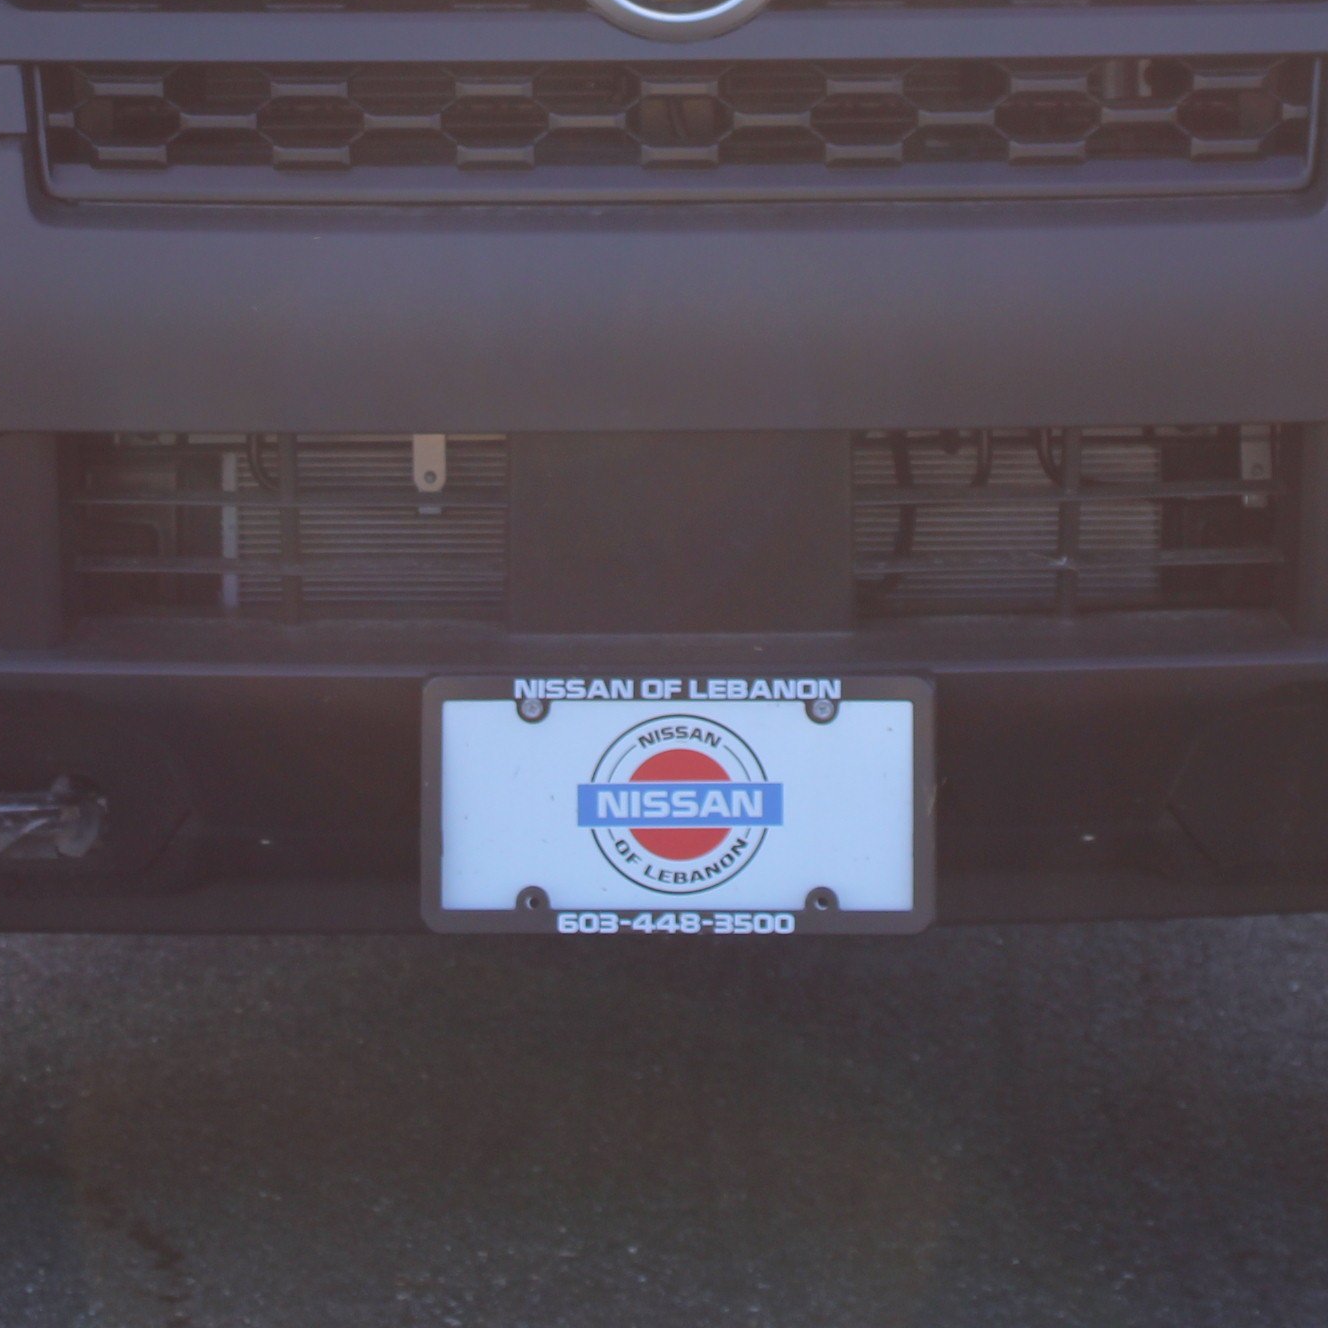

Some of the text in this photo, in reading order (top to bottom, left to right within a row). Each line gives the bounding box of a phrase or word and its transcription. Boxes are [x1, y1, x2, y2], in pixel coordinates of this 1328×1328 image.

[514, 679, 842, 699] NISSAN OF LEBANON
[638, 725, 722, 749] NISSAN
[597, 791, 763, 818] NISSAN
[614, 836, 749, 885] OF LEBANON
[557, 913, 795, 934] 603-448-3500
